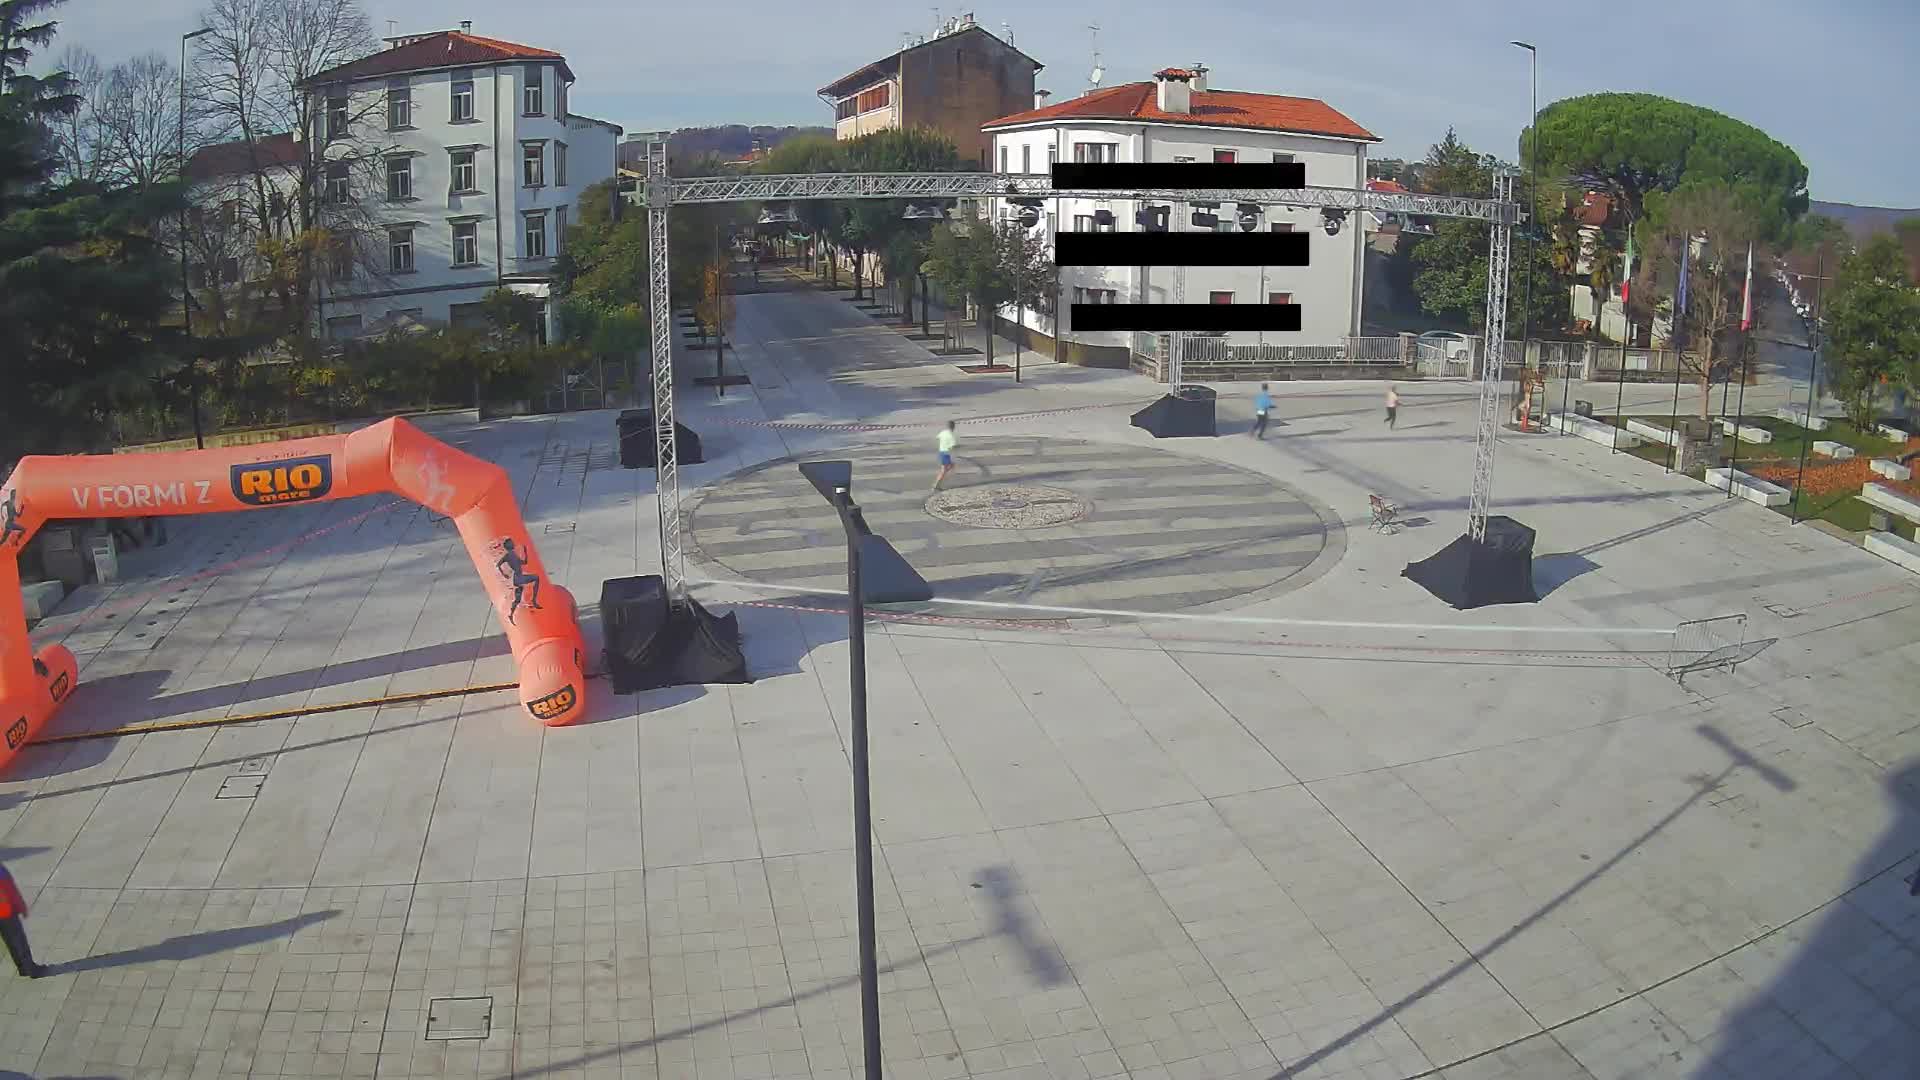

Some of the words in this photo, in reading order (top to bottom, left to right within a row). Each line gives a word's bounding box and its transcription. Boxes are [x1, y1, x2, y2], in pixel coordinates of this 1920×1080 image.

[241, 463, 322, 495] RIO
[72, 487, 89, 510] V
[258, 490, 311, 503] mare
[533, 690, 572, 715] RIO
